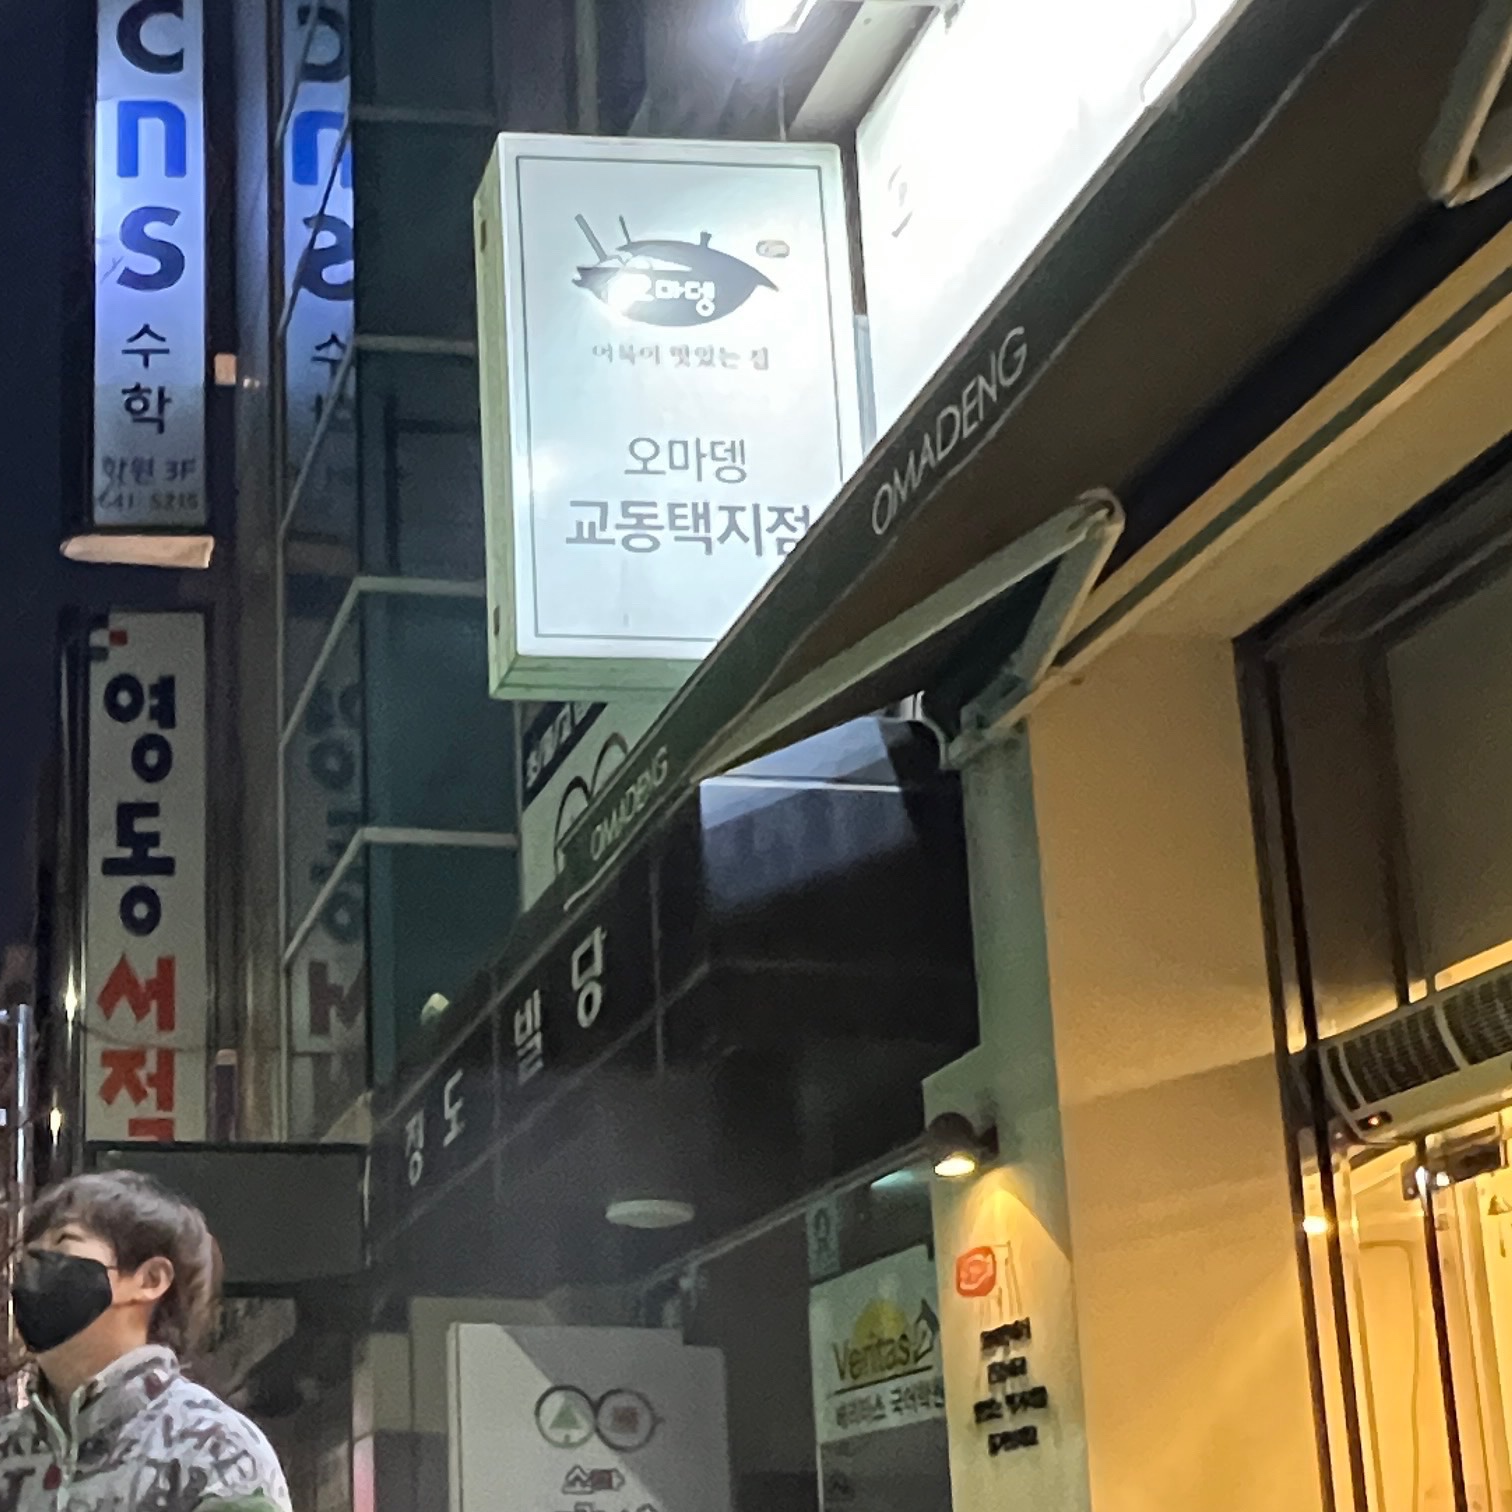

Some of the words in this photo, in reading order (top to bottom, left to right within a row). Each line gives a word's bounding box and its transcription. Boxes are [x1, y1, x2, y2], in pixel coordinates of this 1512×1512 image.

[121, 323, 173, 434] 수학
[623, 436, 748, 484] 오마뎅
[870, 325, 1028, 536] OMADENG
[565, 499, 811, 557] 교동택지점
